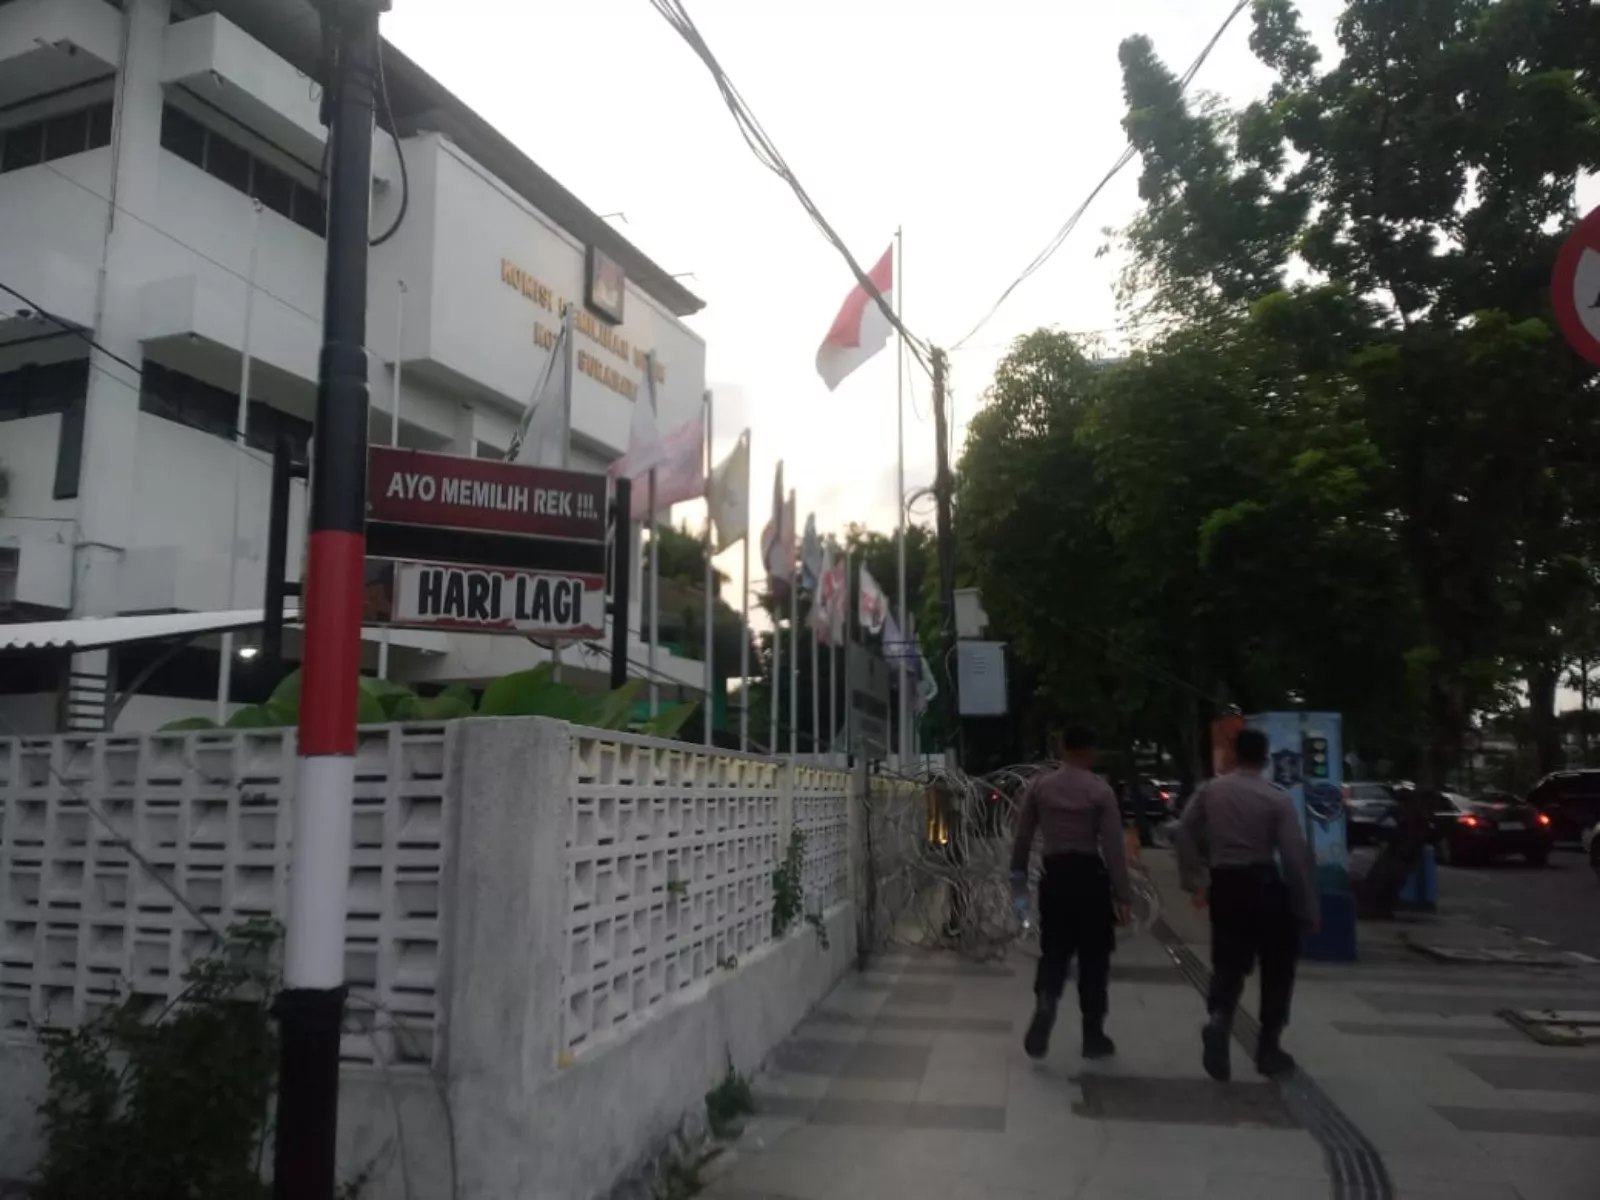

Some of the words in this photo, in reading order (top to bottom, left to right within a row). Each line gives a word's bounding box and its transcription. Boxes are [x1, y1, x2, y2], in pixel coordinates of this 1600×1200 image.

[386, 472, 436, 501] AYO
[441, 478, 528, 512] MEMILIH
[533, 488, 572, 518] REK
[417, 569, 502, 621] HARI
[514, 575, 583, 625] LAGI
